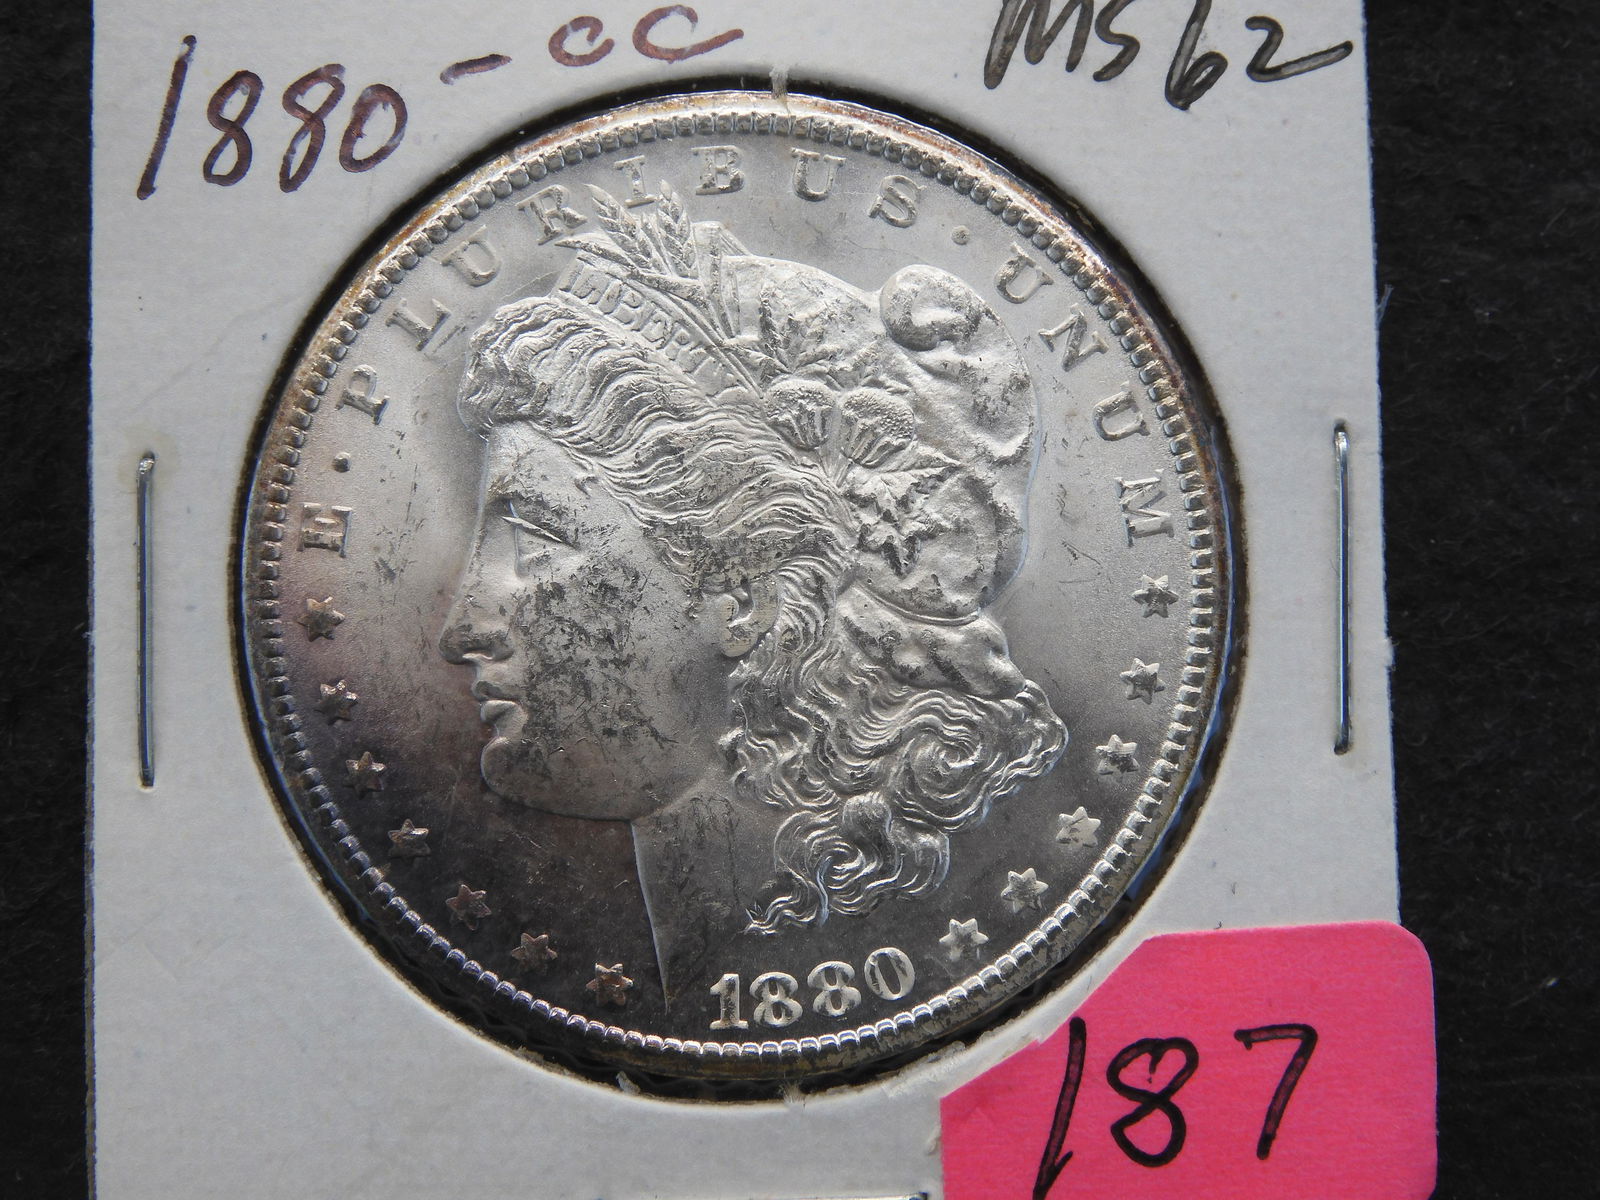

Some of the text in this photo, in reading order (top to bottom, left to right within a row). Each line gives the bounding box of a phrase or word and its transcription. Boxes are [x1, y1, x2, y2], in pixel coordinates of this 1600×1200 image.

[297, 144, 1175, 558] E PLURIBUS UNUM
[709, 946, 915, 1030] 1880
[1033, 1017, 1318, 1200] 187
